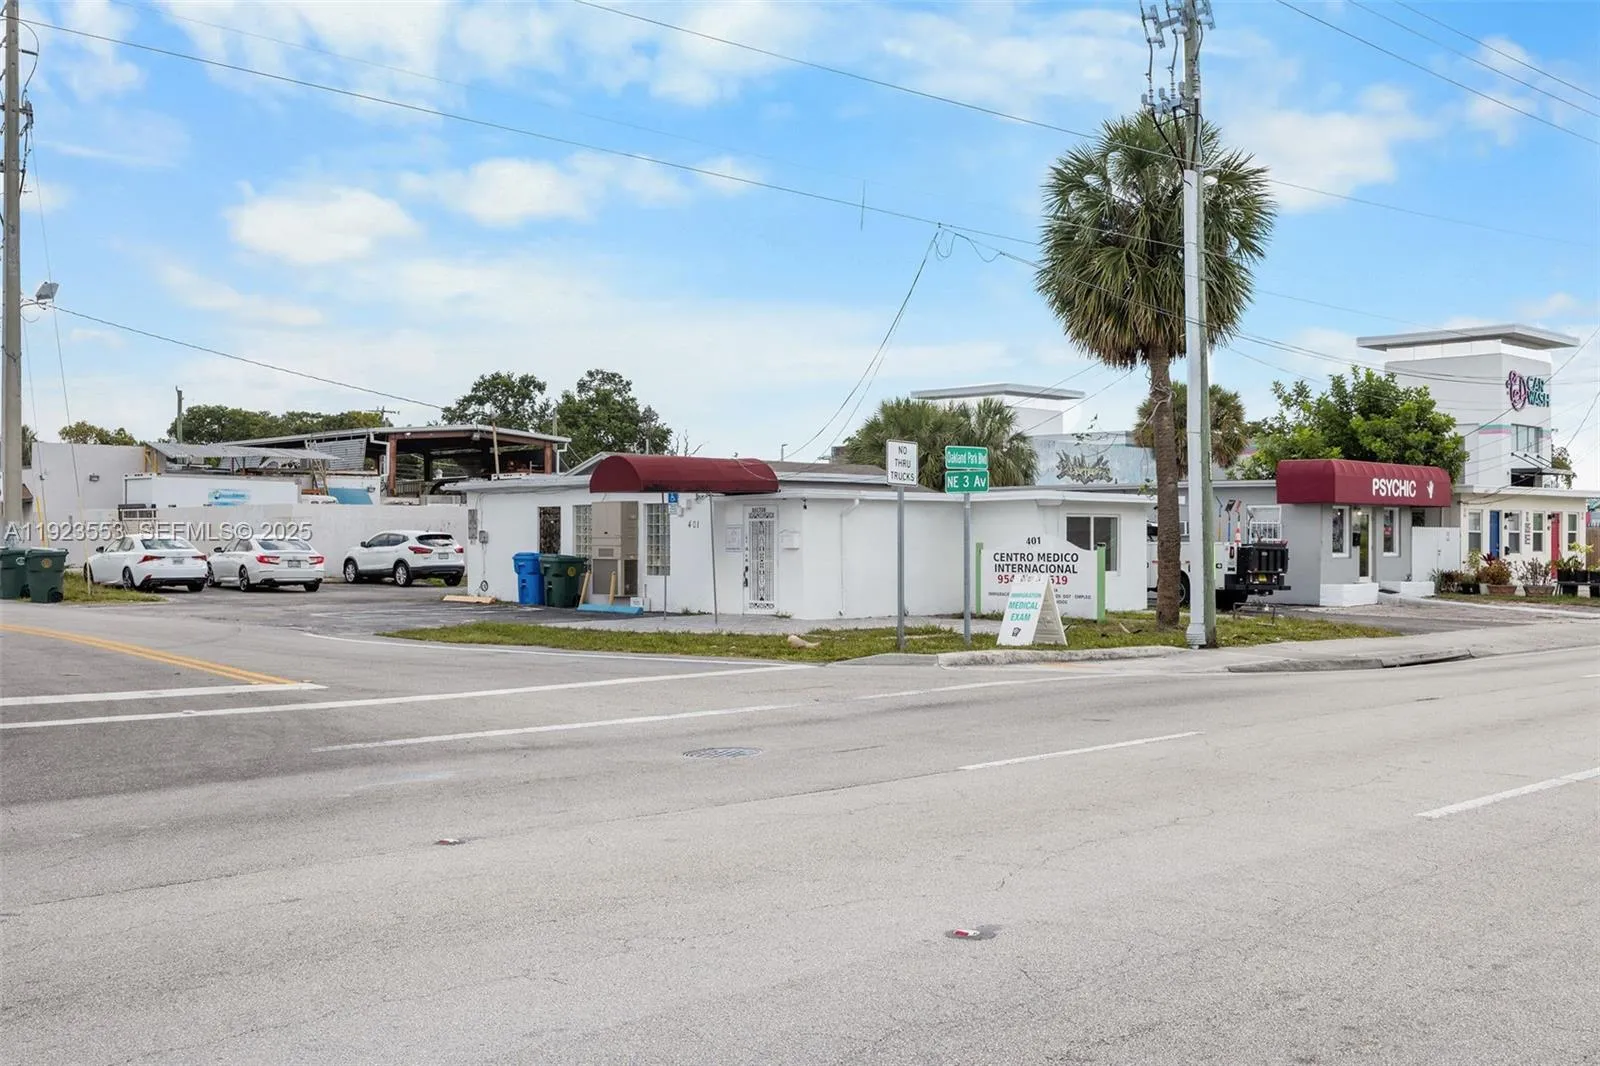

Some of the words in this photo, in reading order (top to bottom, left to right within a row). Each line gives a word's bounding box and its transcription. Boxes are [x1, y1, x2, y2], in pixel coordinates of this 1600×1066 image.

[1527, 391, 1550, 407] WASH
[898, 446, 908, 455] NO
[894, 458, 911, 468] THRU
[947, 451, 967, 464] Oakland
[967, 452, 977, 464] Park
[890, 471, 915, 482] TRUCKS
[947, 475, 959, 488] NE
[962, 475, 970, 488] 3
[973, 475, 987, 487] Av
[1372, 477, 1416, 498] PSYCHIC
[687, 520, 700, 529] 401
[1026, 536, 1041, 545] 401
[993, 552, 1034, 562] CENTRO
[1037, 552, 1079, 563] MEDICO
[994, 563, 1078, 574] INTERNACIONAL
[1008, 600, 1040, 610] MEDICAL
[1010, 612, 1031, 621] EXAM
